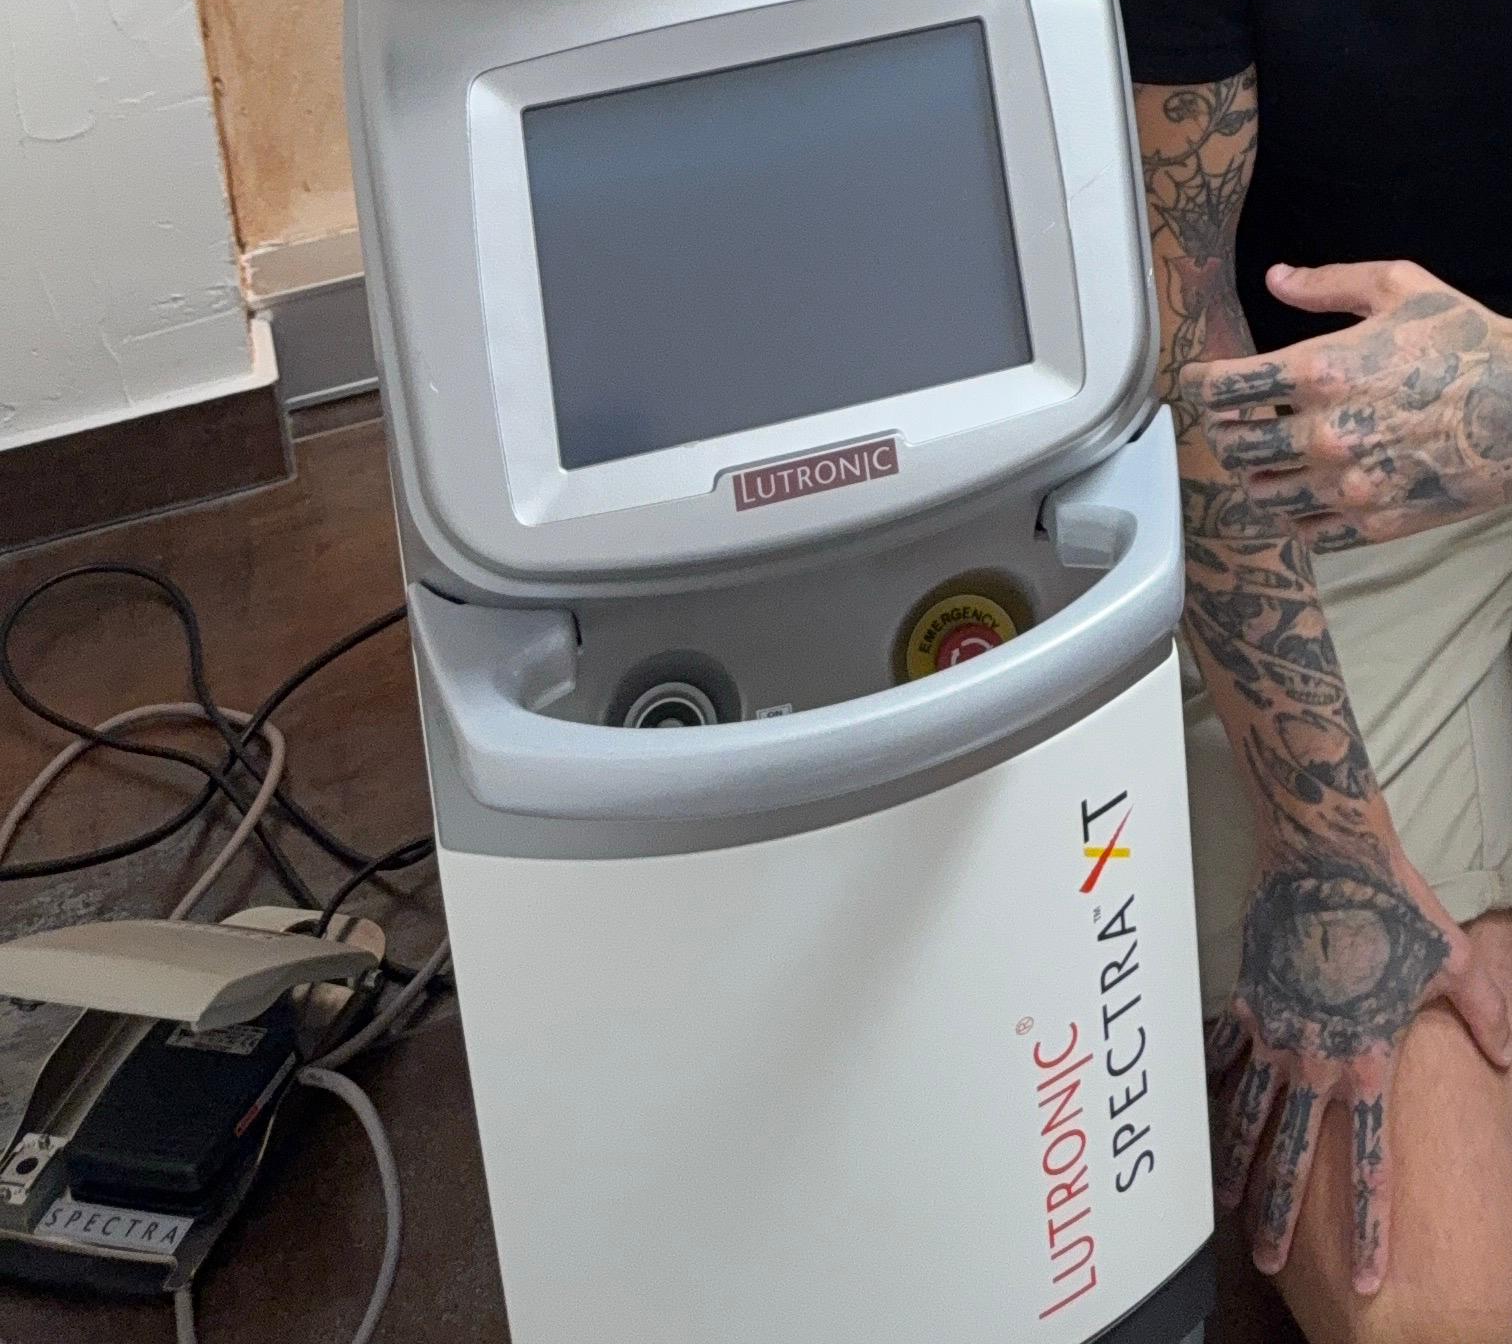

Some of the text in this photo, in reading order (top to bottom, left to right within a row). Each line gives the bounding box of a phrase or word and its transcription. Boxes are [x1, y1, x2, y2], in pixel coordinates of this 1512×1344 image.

[741, 446, 894, 506] LUTRONIC
[919, 605, 1001, 654] EMERGENCY
[1079, 789, 1135, 894] XT
[43, 1207, 180, 1245] SPECTRA
